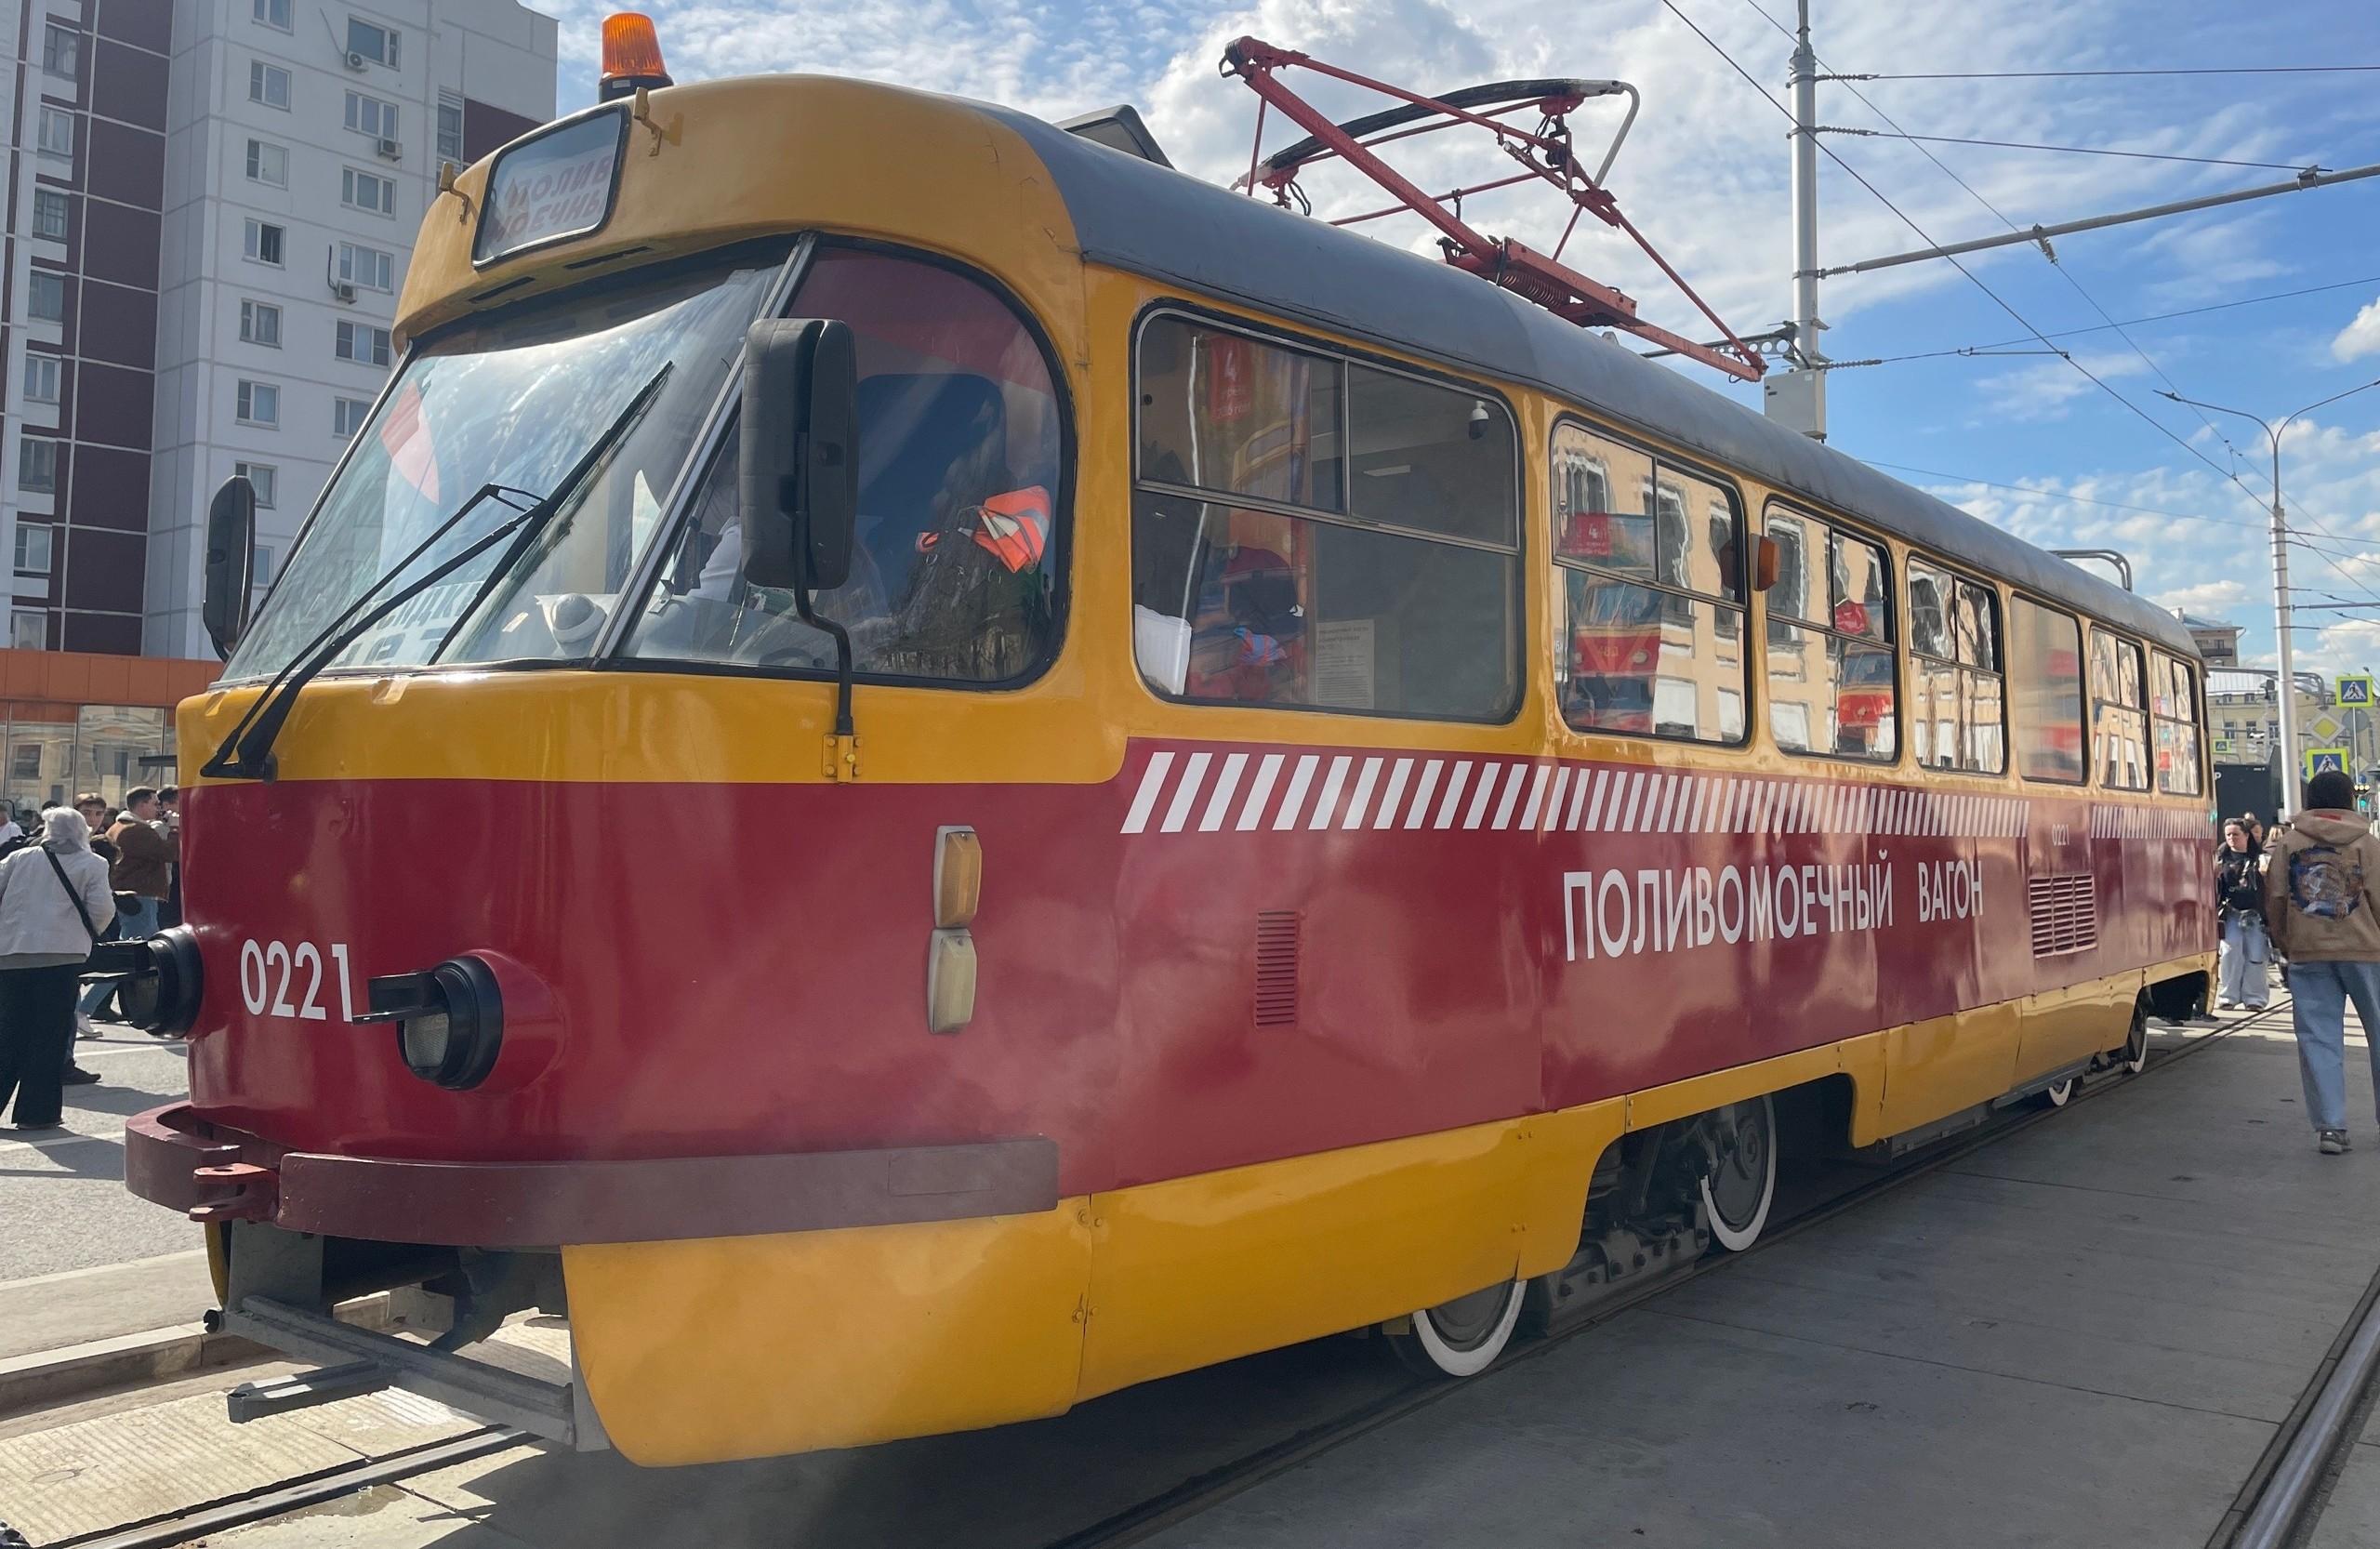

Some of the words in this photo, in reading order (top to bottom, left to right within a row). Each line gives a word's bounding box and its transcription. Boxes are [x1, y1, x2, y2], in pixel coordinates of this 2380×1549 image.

[2052, 824, 2069, 846] 0221
[1564, 849, 1894, 961] ПОЛИВОМОЕЧНЫЙ
[1918, 860, 1984, 922] ВАГОН
[240, 938, 352, 1023] 0221
